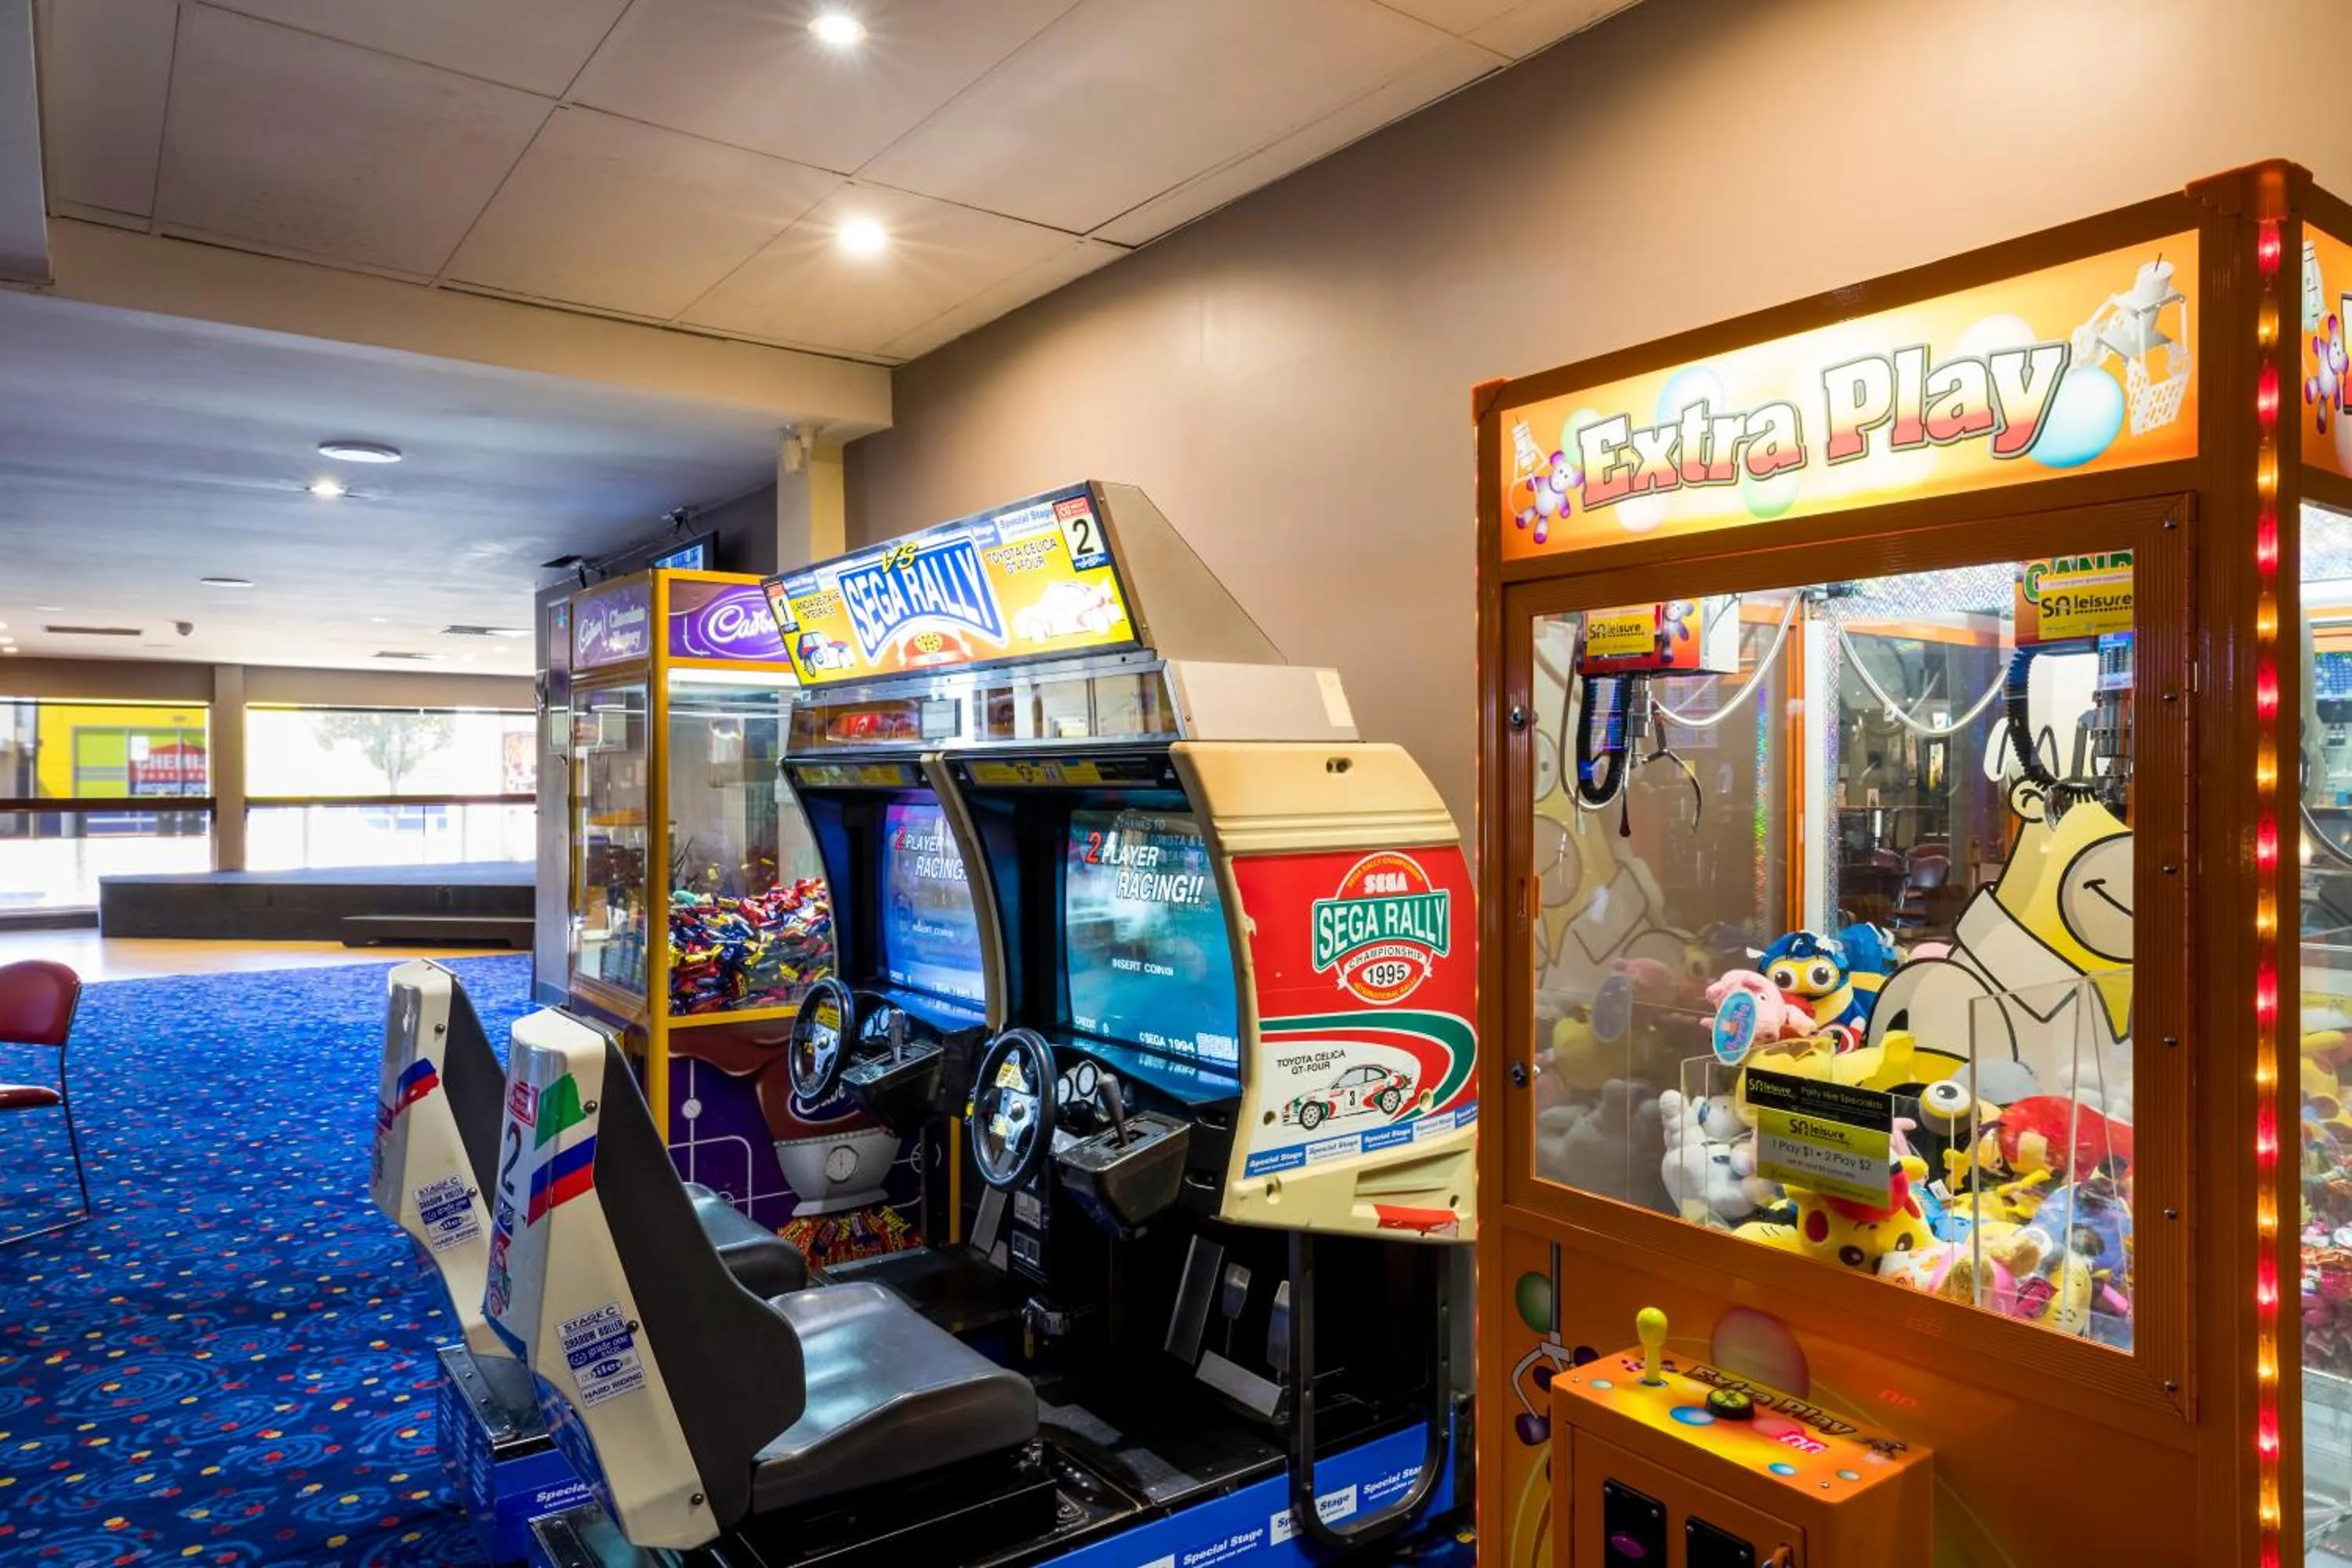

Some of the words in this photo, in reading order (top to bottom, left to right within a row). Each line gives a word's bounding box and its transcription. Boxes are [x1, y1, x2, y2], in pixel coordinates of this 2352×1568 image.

[1577, 397, 1808, 511] Extra
[1821, 343, 2072, 464] Play
[1072, 517, 1095, 556] 2
[880, 541, 920, 574] VS
[843, 570, 910, 651] SEGA
[901, 546, 994, 630] RALLY
[2074, 593, 2133, 609] leisure
[895, 825, 907, 851] 2
[906, 833, 945, 852] PLAYER
[1084, 829, 1102, 864] 2
[1101, 844, 1160, 868] PLAYER
[915, 855, 968, 882] RACING
[1116, 870, 1205, 904] RACING!!
[1363, 872, 1409, 894] SEGA
[1319, 904, 1380, 960] SEGA
[1384, 898, 1446, 946] RALLY
[1112, 957, 1142, 972] INSERT
[1348, 946, 1423, 969] CHAMPIONSHIP
[1367, 963, 1406, 985] 1995
[1167, 1037, 1195, 1054] 1994
[1276, 1054, 1313, 1069] TOYOTA
[1314, 1049, 1347, 1063] CELICA
[1290, 1060, 1331, 1076] GT-FOUR
[1349, 1090, 1356, 1108] 3
[1364, 1131, 1392, 1144] Special
[1392, 1126, 1412, 1139] Stage
[1809, 1122, 1846, 1141] leisure
[501, 1120, 522, 1196] 2
[1248, 1155, 1279, 1169] Special
[1279, 1150, 1304, 1163] Stage
[1778, 1140, 1802, 1156] Play
[1833, 1153, 1857, 1168] Play
[1858, 1159, 1872, 1171] $2
[564, 1310, 604, 1330] STAGE
[605, 1306, 616, 1316] C
[584, 1385, 611, 1399] HARD
[611, 1371, 643, 1389] RIDING
[1777, 1398, 1858, 1436] Play
[535, 1483, 586, 1503] Specia
[1363, 1473, 1401, 1495] Special
[1319, 1493, 1351, 1512] Stage
[1184, 1541, 1229, 1566] Special
[1230, 1530, 1264, 1548] Stage
